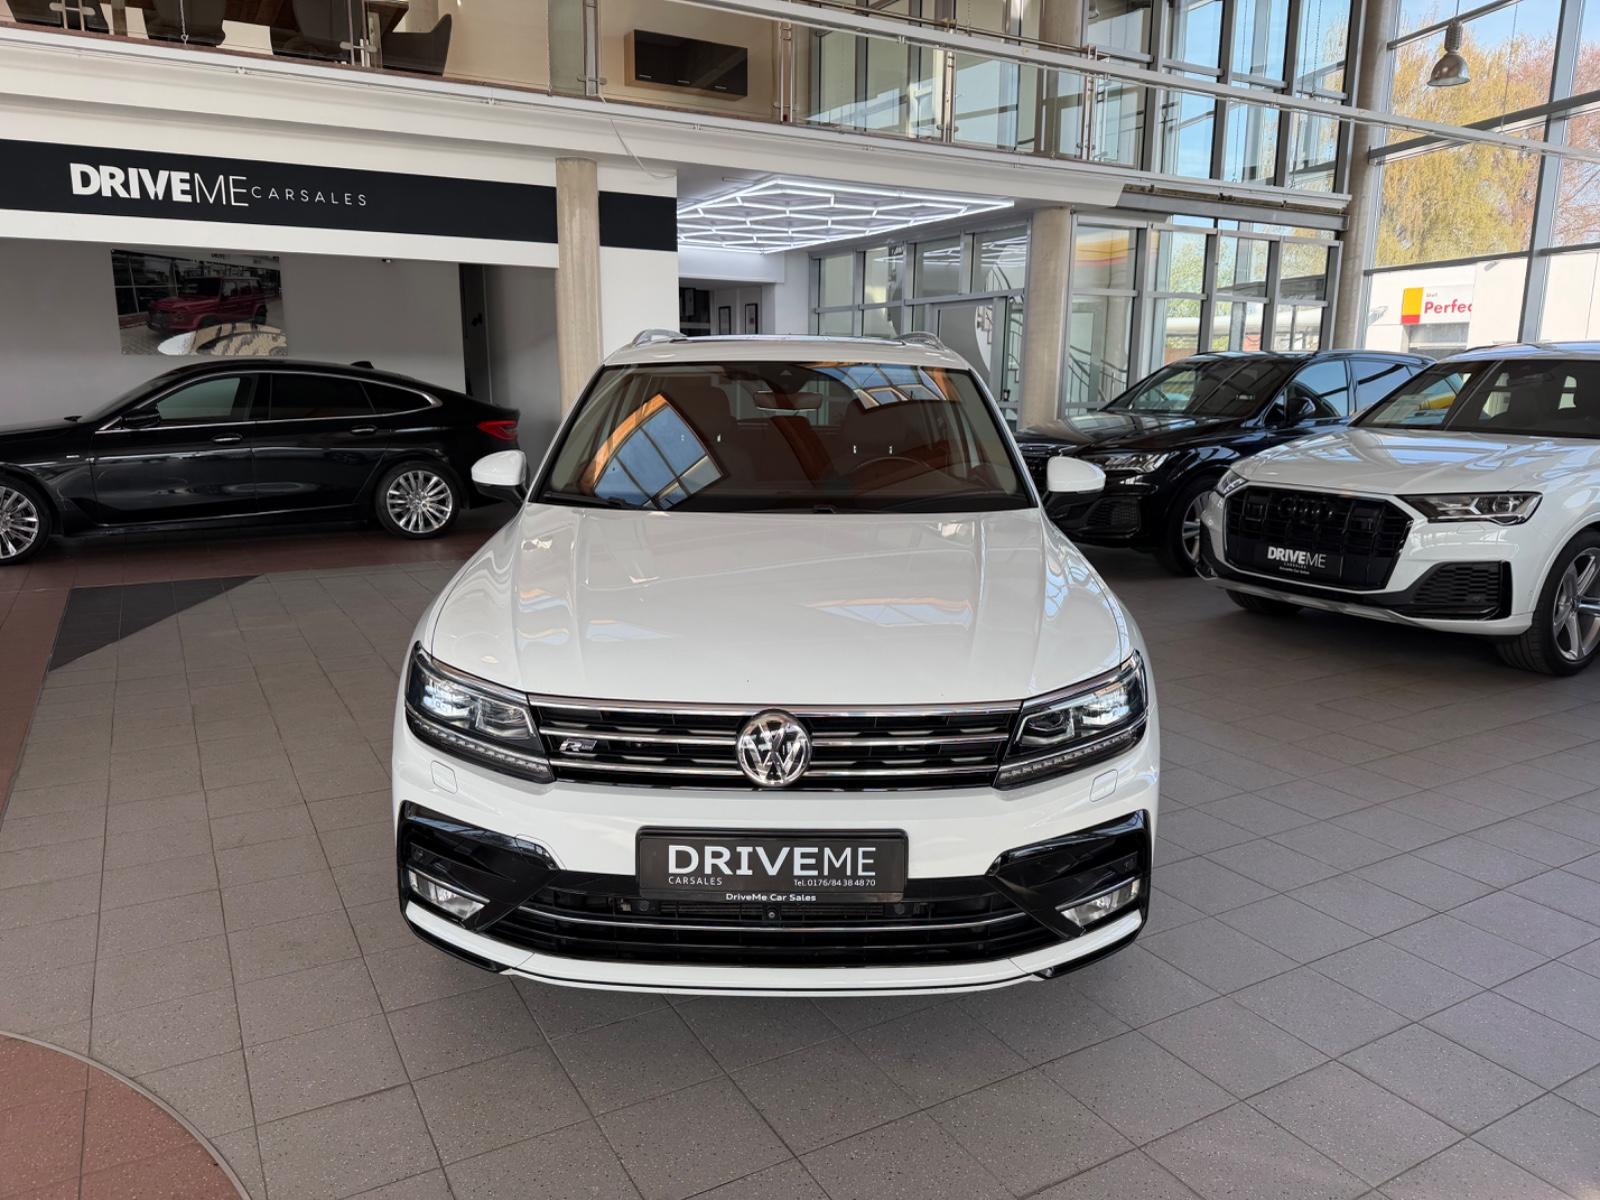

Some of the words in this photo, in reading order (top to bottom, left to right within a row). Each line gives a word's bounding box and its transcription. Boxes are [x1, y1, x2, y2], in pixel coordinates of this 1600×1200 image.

[69, 162, 249, 207] DRIVEME
[251, 186, 367, 206] CARSALES
[1267, 546, 1327, 568] DRIVEME
[668, 845, 876, 876] DRIVEME
[668, 876, 723, 886] CARSALES
[725, 893, 768, 901] DriveMe
[769, 893, 787, 902] Car
[789, 893, 817, 902] Sales
